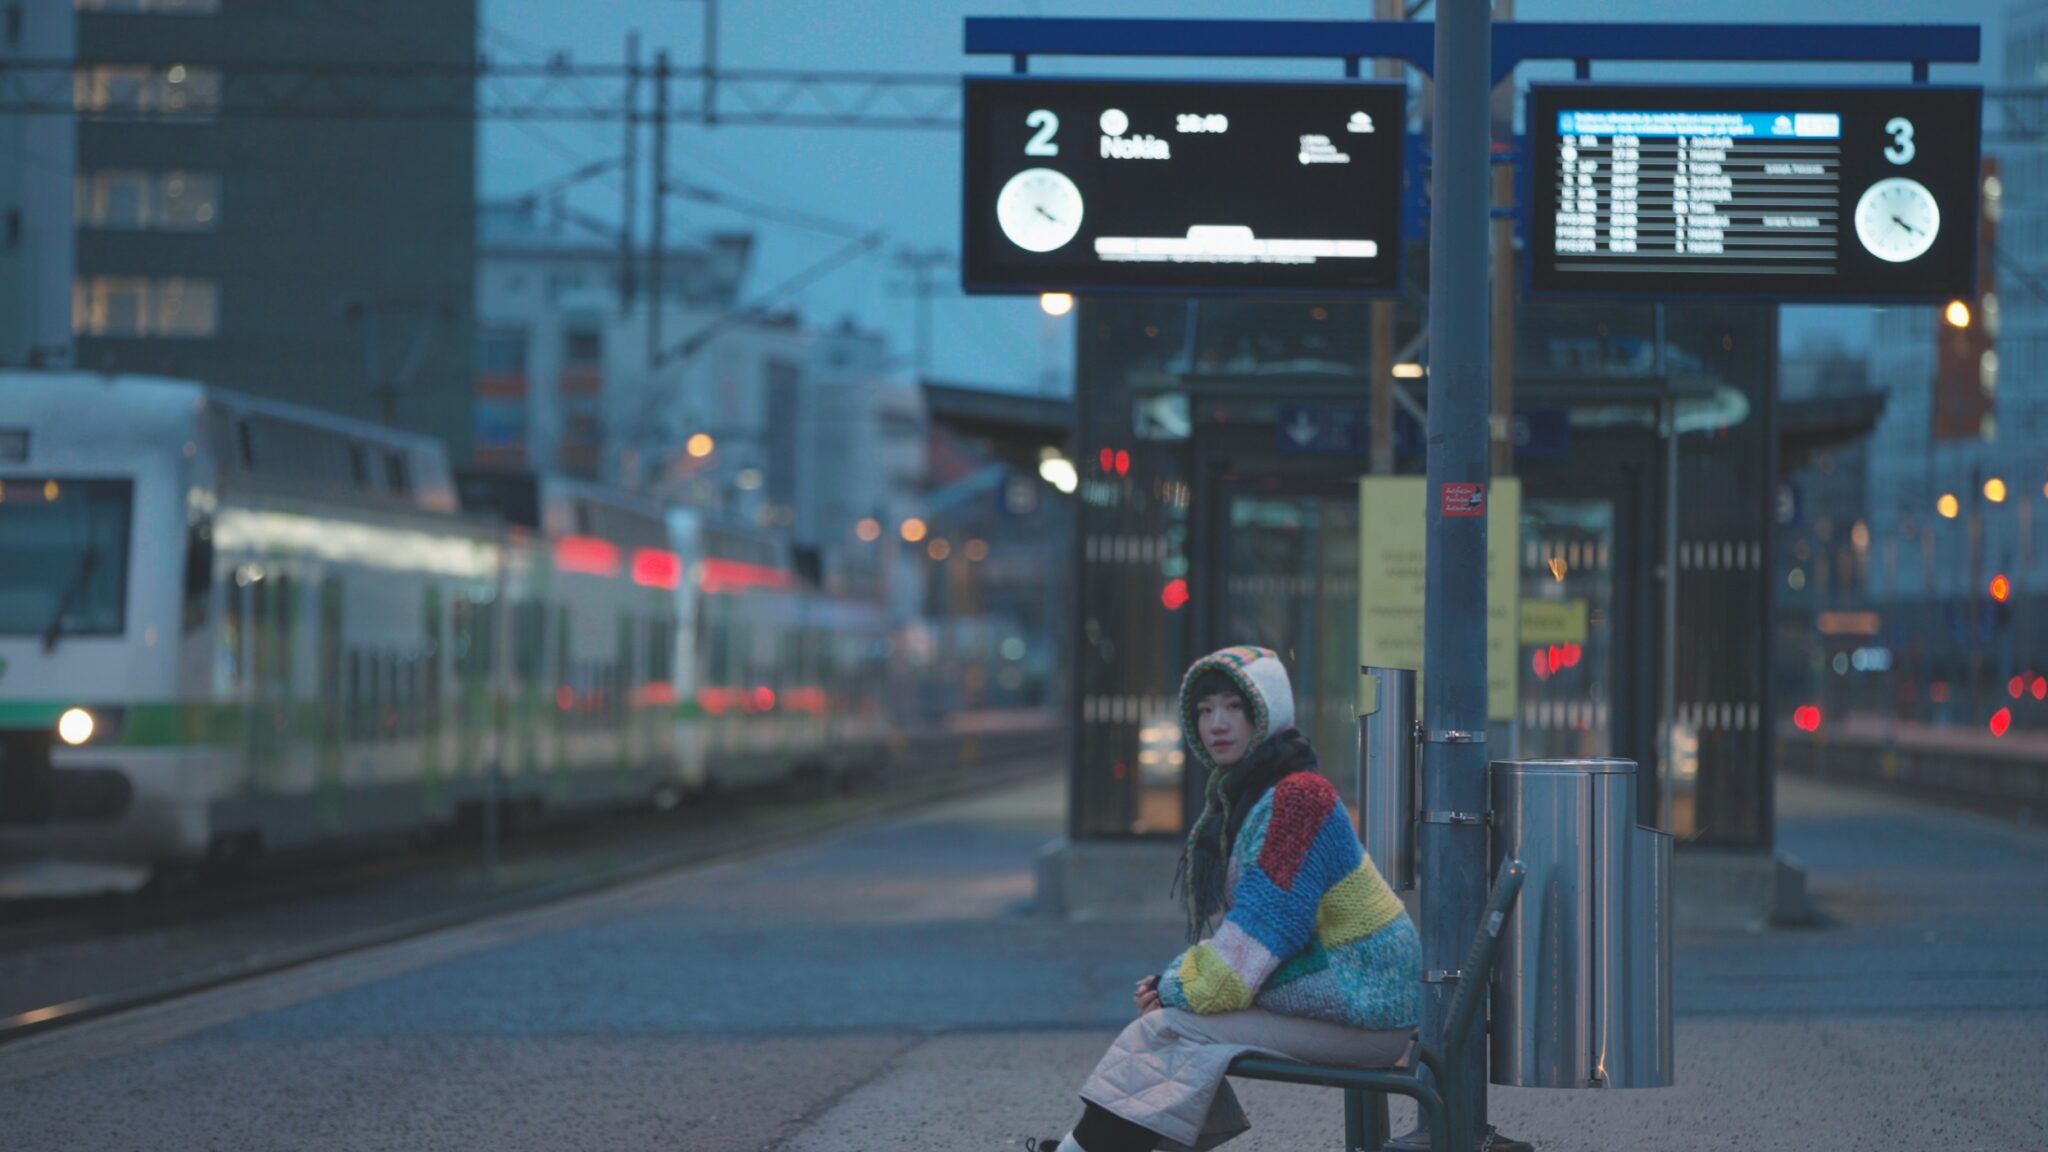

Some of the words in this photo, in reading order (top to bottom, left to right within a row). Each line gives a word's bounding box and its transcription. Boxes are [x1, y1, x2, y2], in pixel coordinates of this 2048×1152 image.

[1025, 109, 1059, 156] 2
[1100, 134, 1171, 160] Nokia
[1884, 118, 1915, 165] 3
